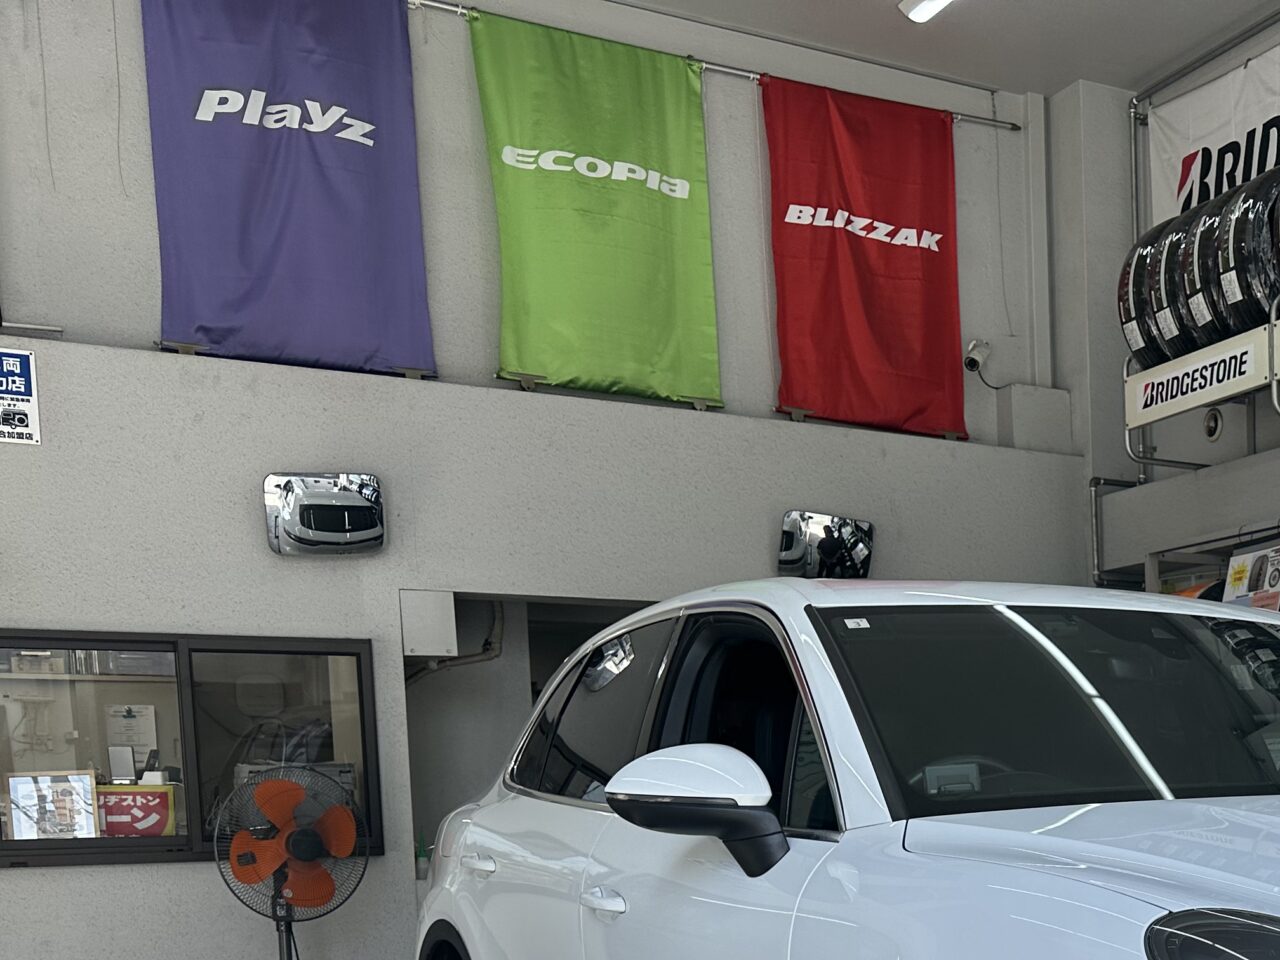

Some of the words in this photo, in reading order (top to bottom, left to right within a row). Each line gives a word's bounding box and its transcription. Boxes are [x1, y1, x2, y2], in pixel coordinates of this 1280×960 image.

[195, 90, 377, 147] Playz
[784, 203, 944, 252] BLIZZAK
[1142, 349, 1249, 410] BRIDGESTONE
